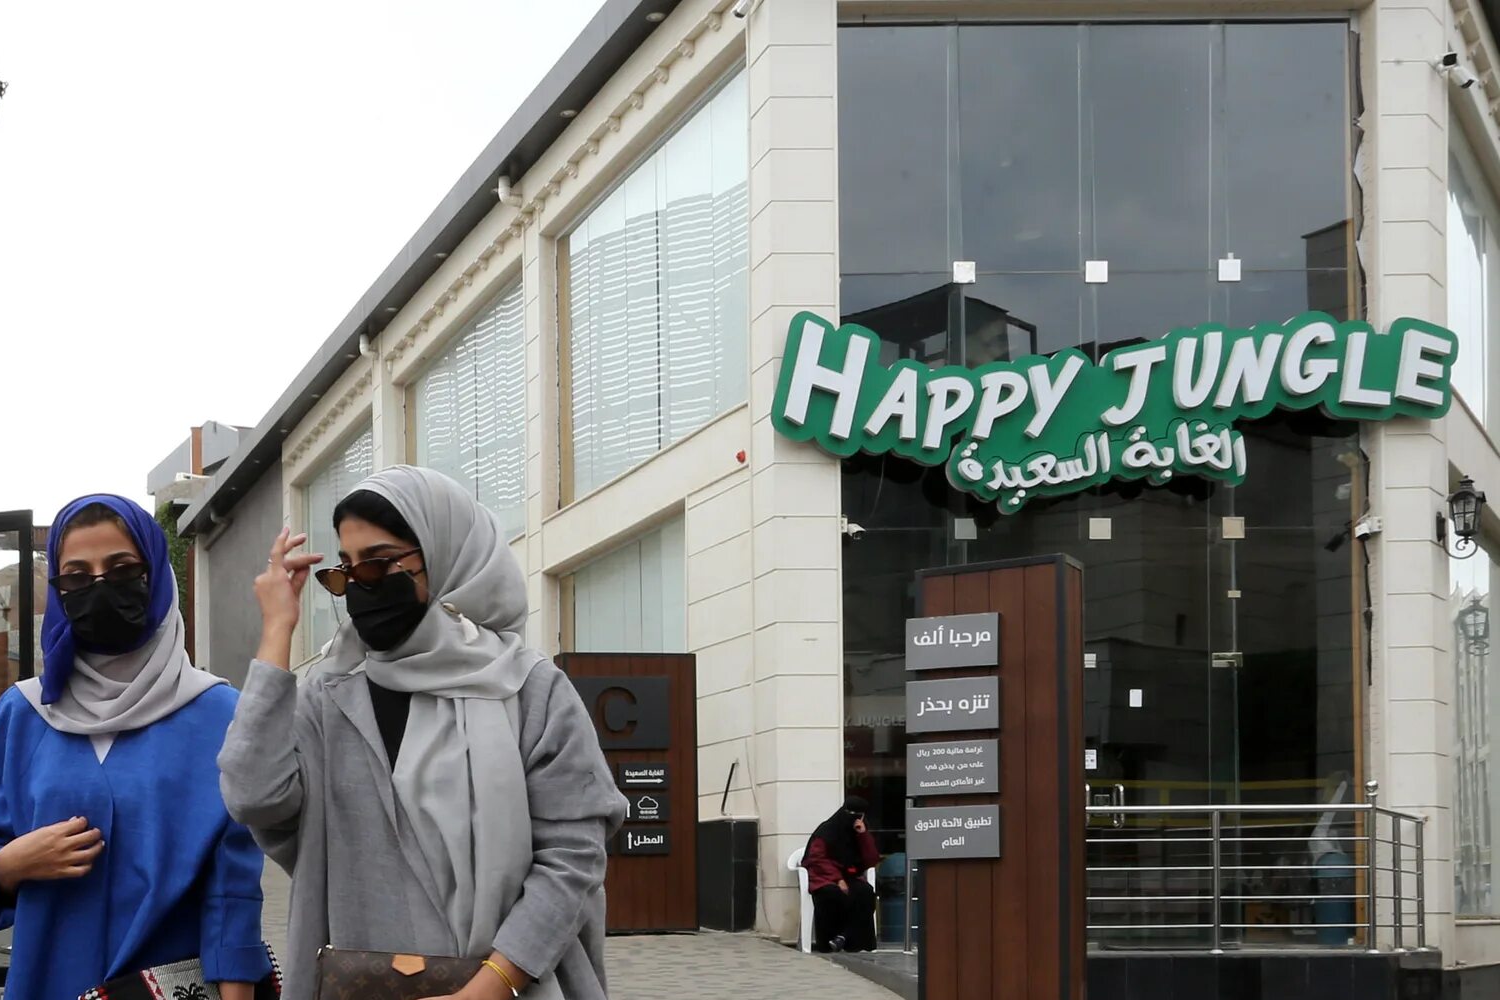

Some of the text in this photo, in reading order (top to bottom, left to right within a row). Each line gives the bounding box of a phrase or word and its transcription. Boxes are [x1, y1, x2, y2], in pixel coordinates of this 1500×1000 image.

[784, 319, 1452, 450] HAPPY JUNGLE
[957, 422, 1246, 505] الغابة السعيدة
[913, 625, 991, 647] مرحبا ألف
[917, 694, 990, 716] تنزه بحذر
[595, 686, 637, 740] C
[916, 749, 930, 758] ريال
[946, 747, 964, 756] مالية
[925, 763, 938, 772] في
[969, 761, 984, 769] على
[914, 816, 992, 832] تطبيق لائحة الذوق
[633, 835, 663, 846] المطل
[941, 836, 965, 849] العام
